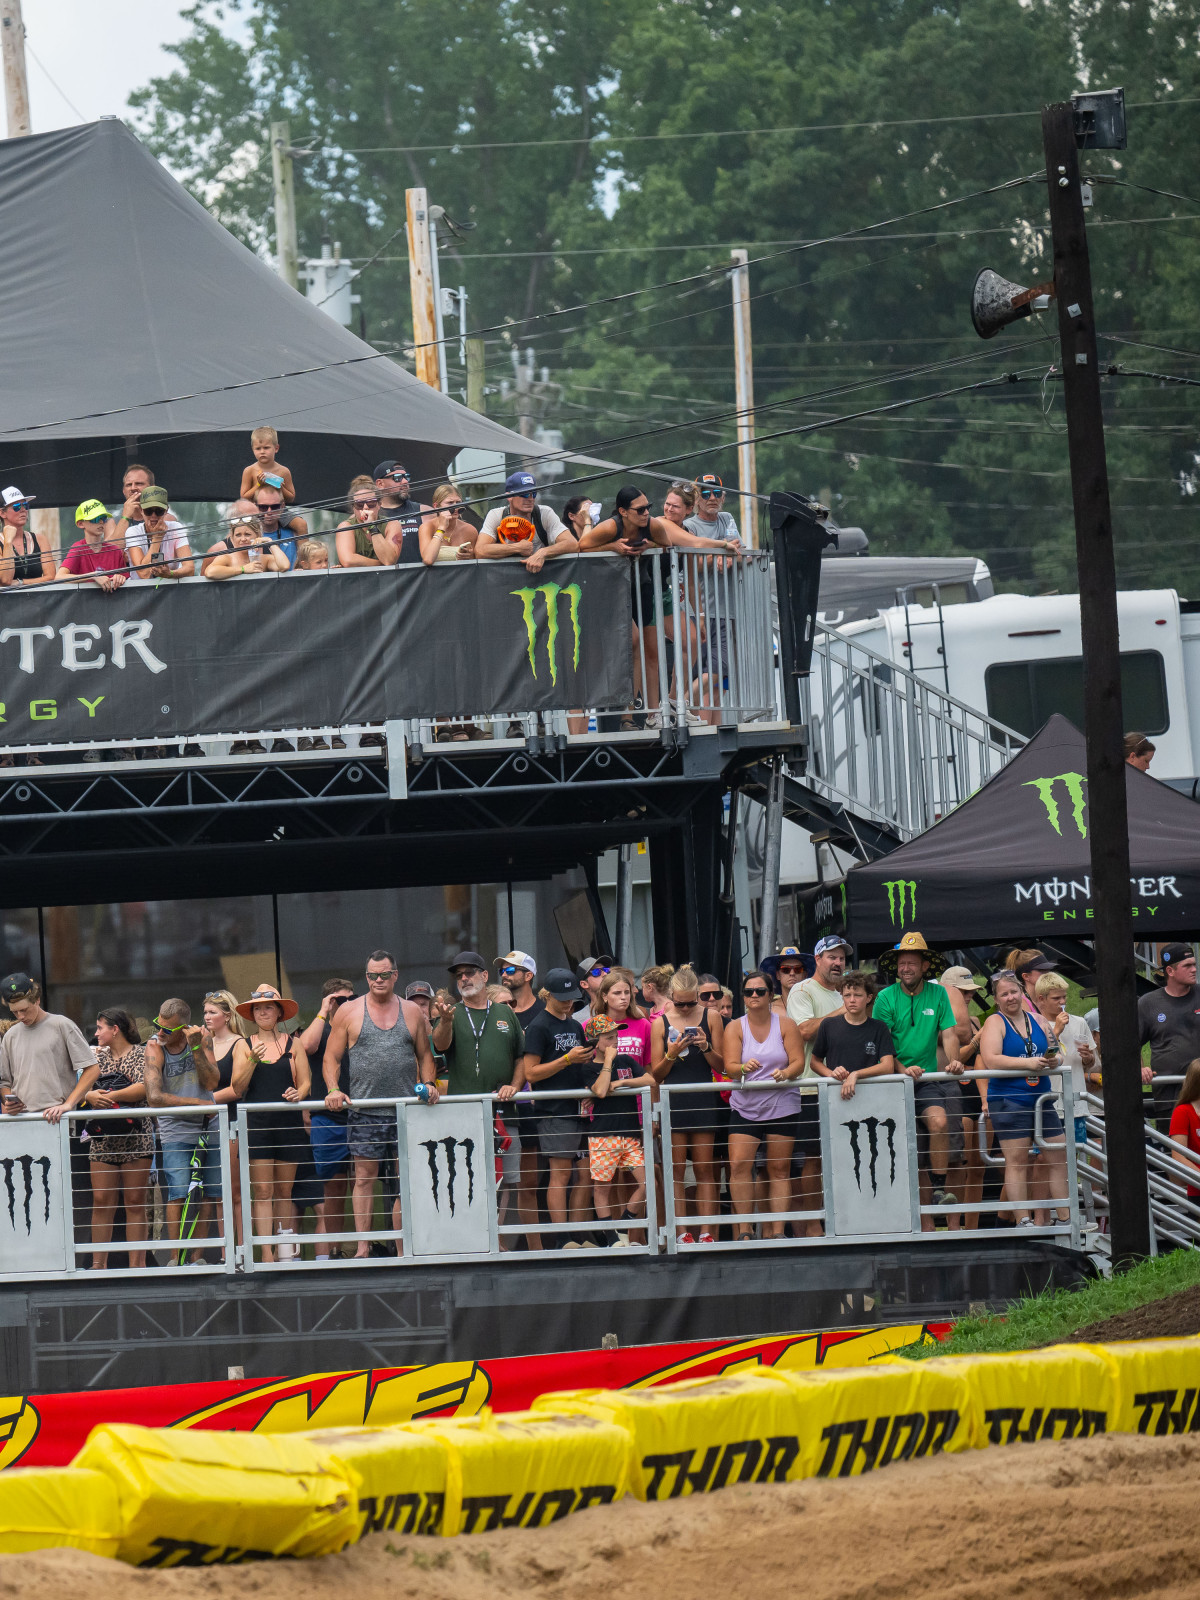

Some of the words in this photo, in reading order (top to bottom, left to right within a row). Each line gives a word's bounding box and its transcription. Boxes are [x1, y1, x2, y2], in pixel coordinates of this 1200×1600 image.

[1014, 875, 1183, 906] MONER
[1043, 906, 1159, 921] ENEGY
[984, 1407, 1107, 1444] THOR
[1133, 1388, 1200, 1437] TH
[816, 1409, 960, 1478] THOR
[642, 1436, 799, 1502] THOR
